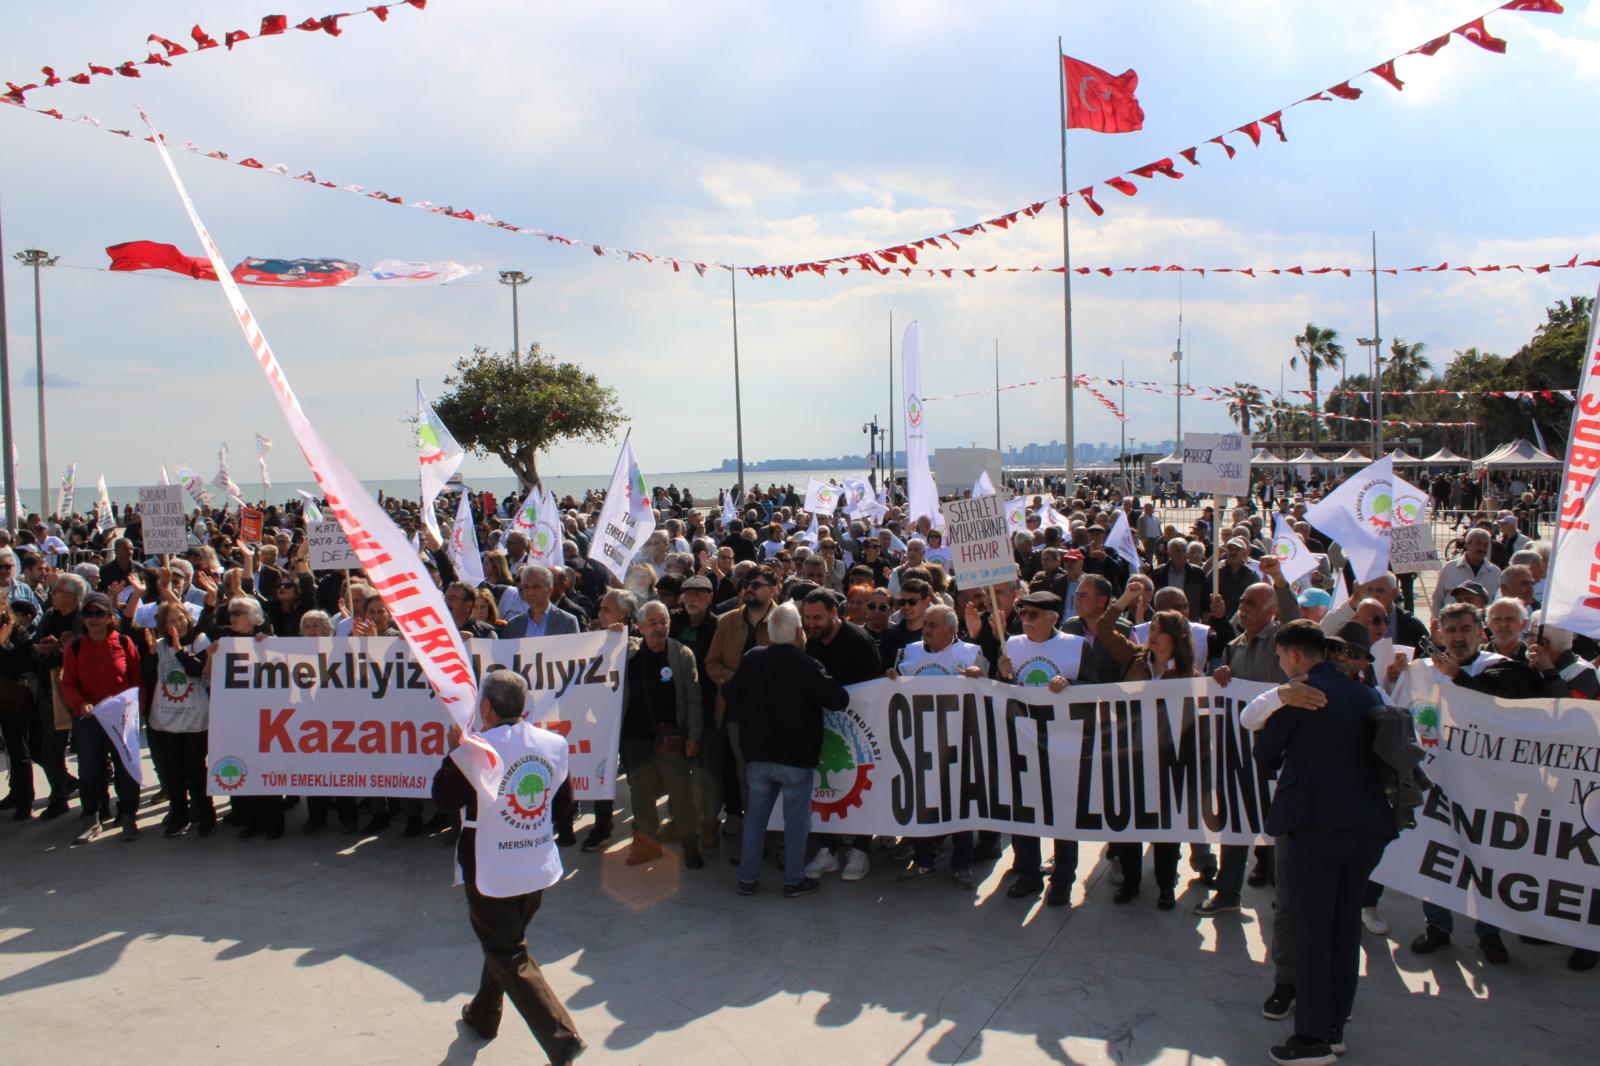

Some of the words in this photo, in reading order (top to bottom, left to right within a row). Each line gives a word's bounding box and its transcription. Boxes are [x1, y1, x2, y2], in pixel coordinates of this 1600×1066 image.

[949, 495, 998, 524] SEFALET
[961, 541, 1000, 563] HAYIR
[846, 708, 882, 761] ENDİKASI
[1443, 722, 1502, 761] TÜM
[888, 692, 1055, 826] SEFALET
[261, 772, 287, 787] TÜM
[291, 771, 367, 788] EMEKLİLERİN
[370, 773, 427, 790] SENDİKASI
[814, 788, 836, 799] 2017
[498, 839, 533, 851] MERSİN
